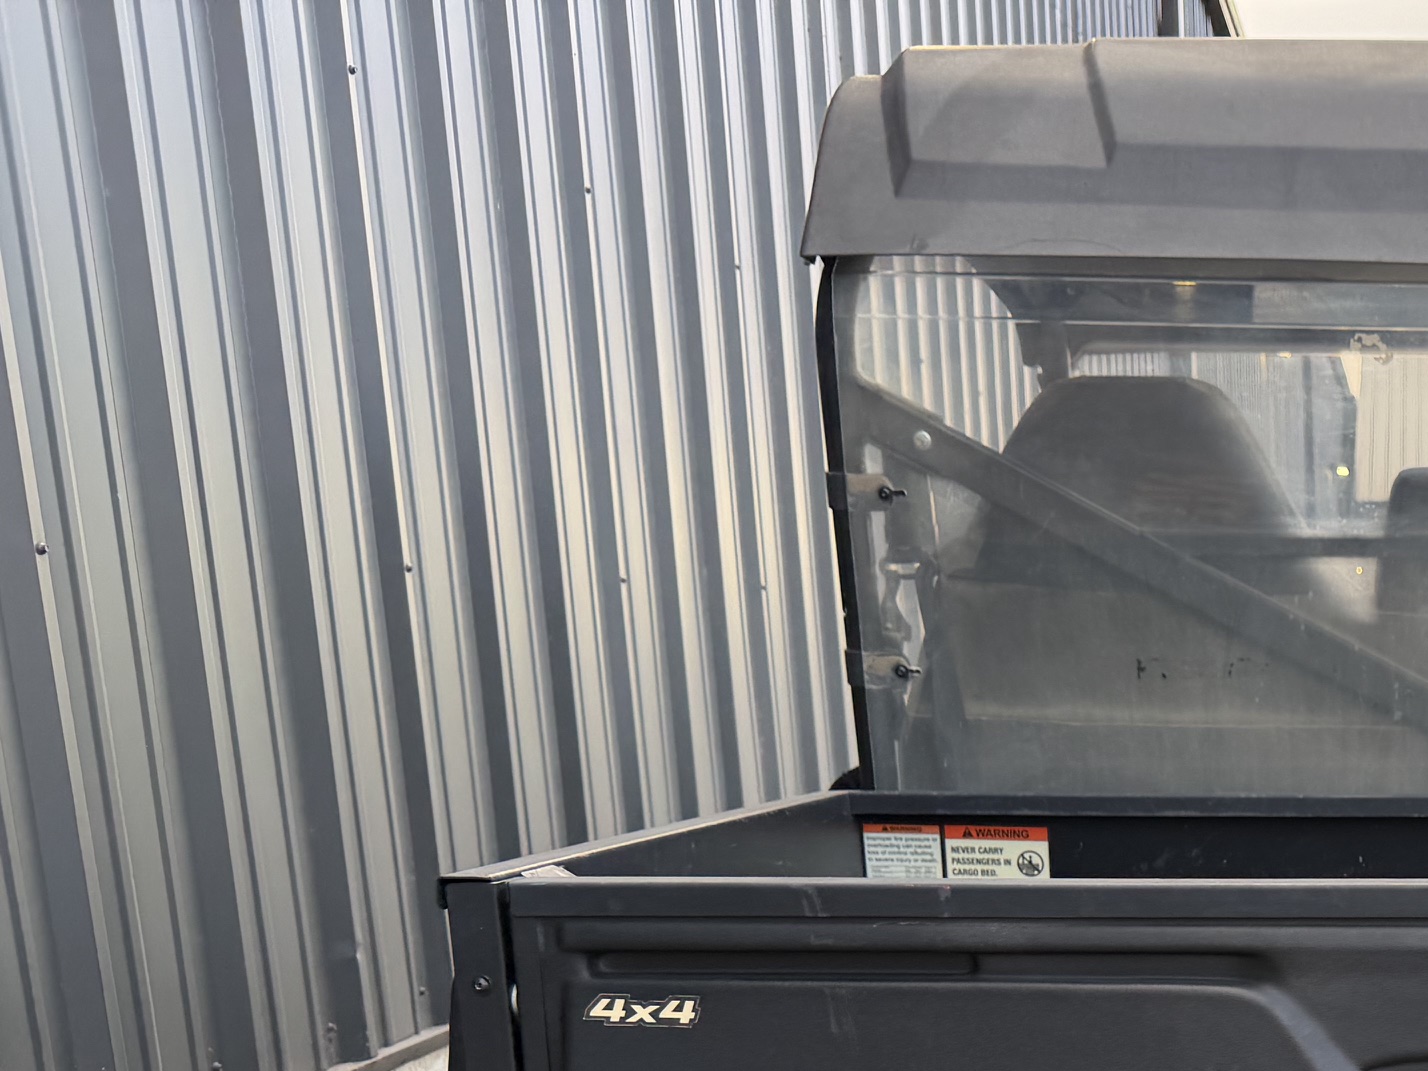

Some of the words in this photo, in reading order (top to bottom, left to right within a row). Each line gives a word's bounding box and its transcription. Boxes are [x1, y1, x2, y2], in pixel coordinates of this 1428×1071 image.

[975, 828, 1030, 838] WARNING
[951, 845, 976, 854] NEVER
[978, 846, 1004, 855] CARRY
[951, 857, 1002, 866] PASSENGERS
[1003, 858, 1012, 866] IN
[952, 868, 979, 876] CARGO
[981, 869, 998, 877] BED.
[589, 998, 696, 1024] 4x4
